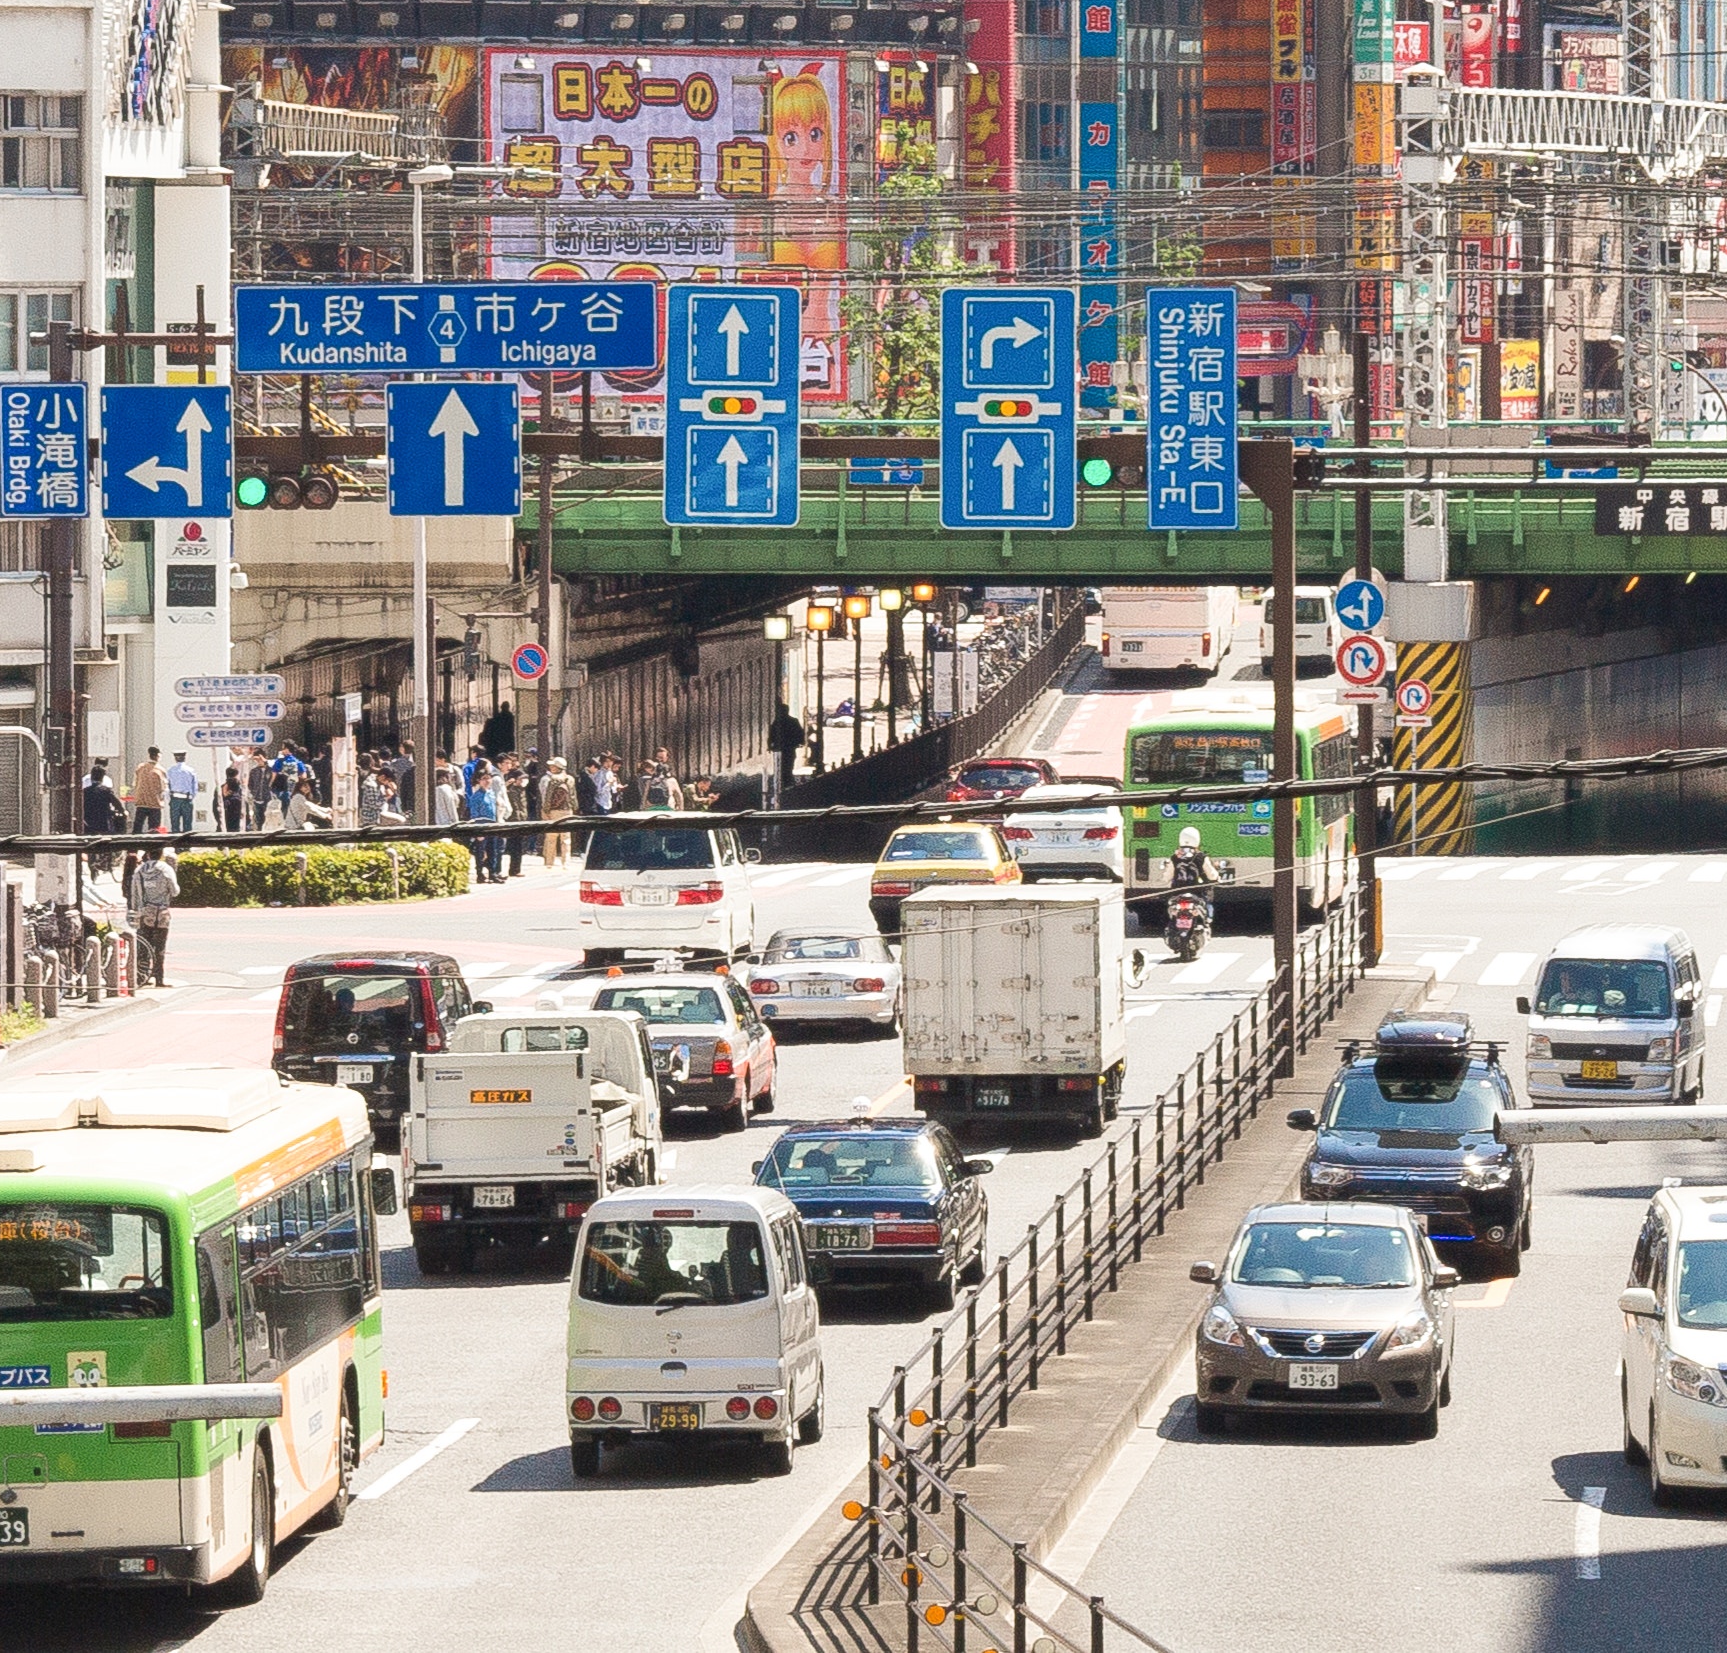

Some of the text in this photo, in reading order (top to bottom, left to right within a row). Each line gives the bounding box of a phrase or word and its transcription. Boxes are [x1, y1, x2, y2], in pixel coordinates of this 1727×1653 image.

[553, 62, 718, 121] 日本一の
[503, 136, 771, 198] 超大型店
[269, 295, 420, 336] 九段下
[280, 341, 596, 366] Kudanshita Ichigaya
[1157, 307, 1183, 415] Shinjuku
[8, 392, 29, 448] Otaki
[1188, 302, 1225, 514] 新宿駅東口
[36, 394, 78, 510] 小滝橋
[1635, 489, 1720, 505] 中央線
[172, 546, 211, 556] バーミヤン
[472, 1091, 530, 1102] 高圧ガス
[1299, 1374, 1336, 1387] 93-63
[660, 1414, 698, 1428] 29-99
